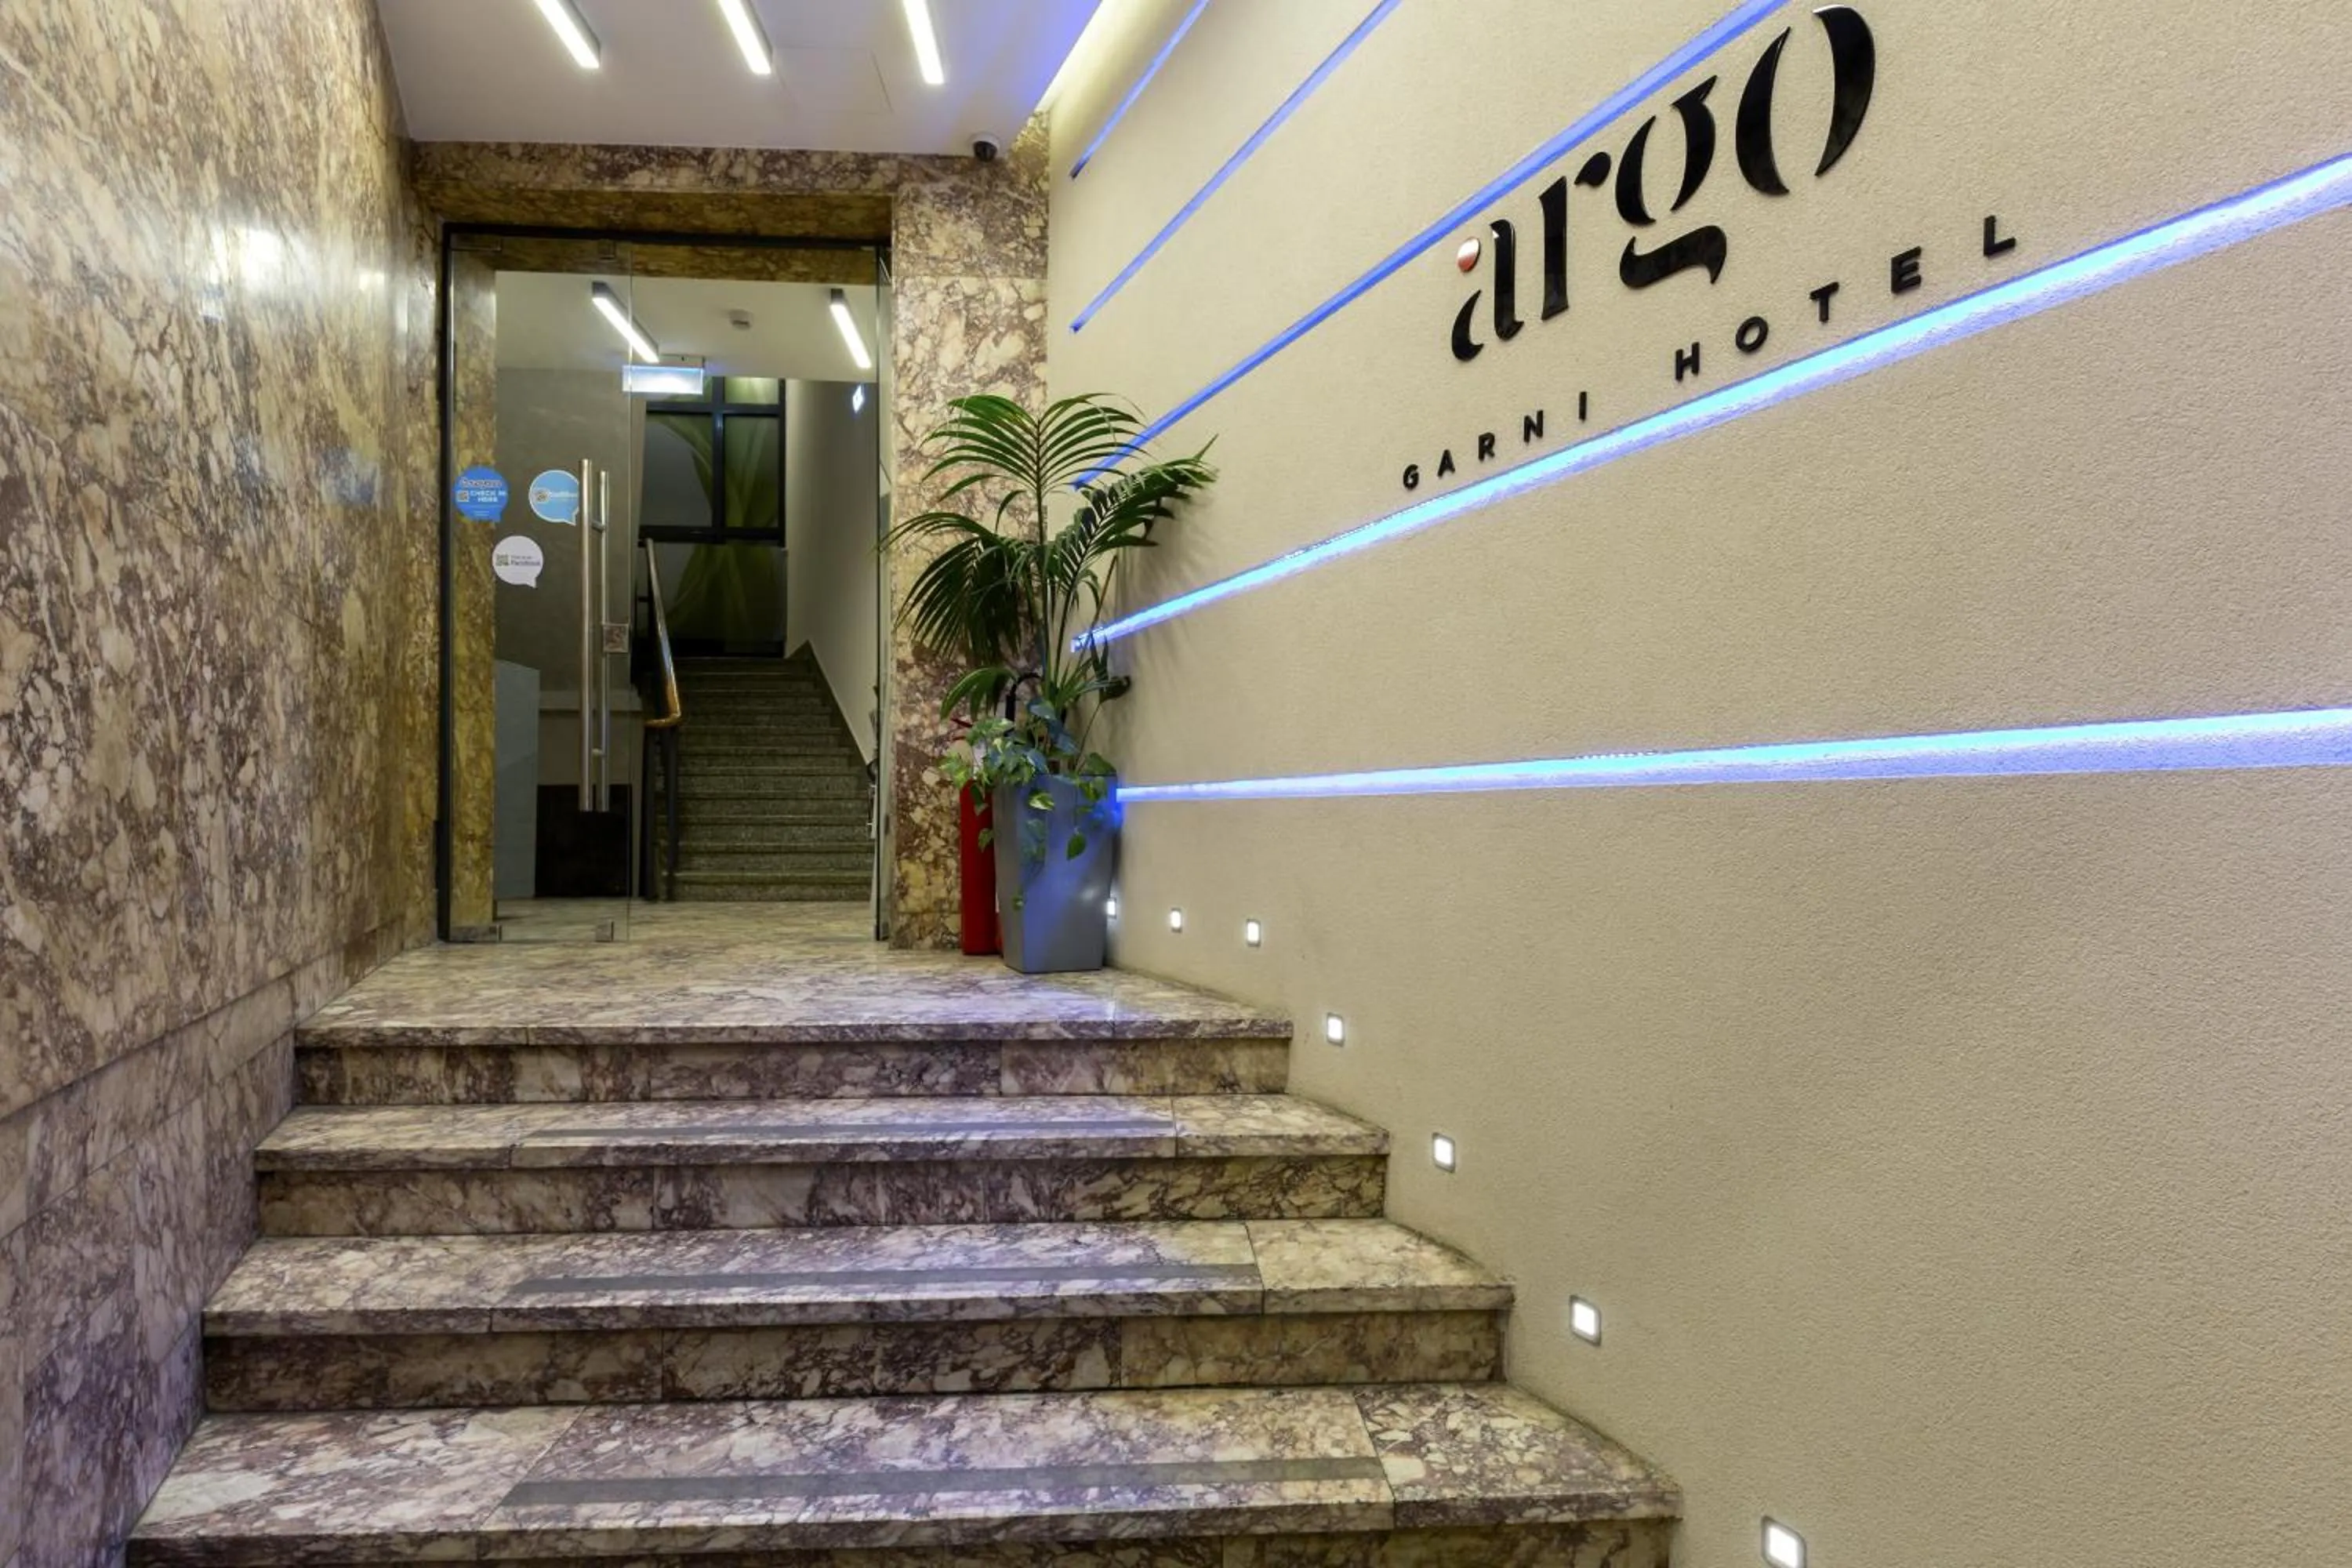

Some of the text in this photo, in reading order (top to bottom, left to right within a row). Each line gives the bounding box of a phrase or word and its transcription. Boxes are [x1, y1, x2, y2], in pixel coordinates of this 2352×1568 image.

[1451, 4, 1876, 363] argo
[1403, 215, 2016, 491] GARNI HOTEL
